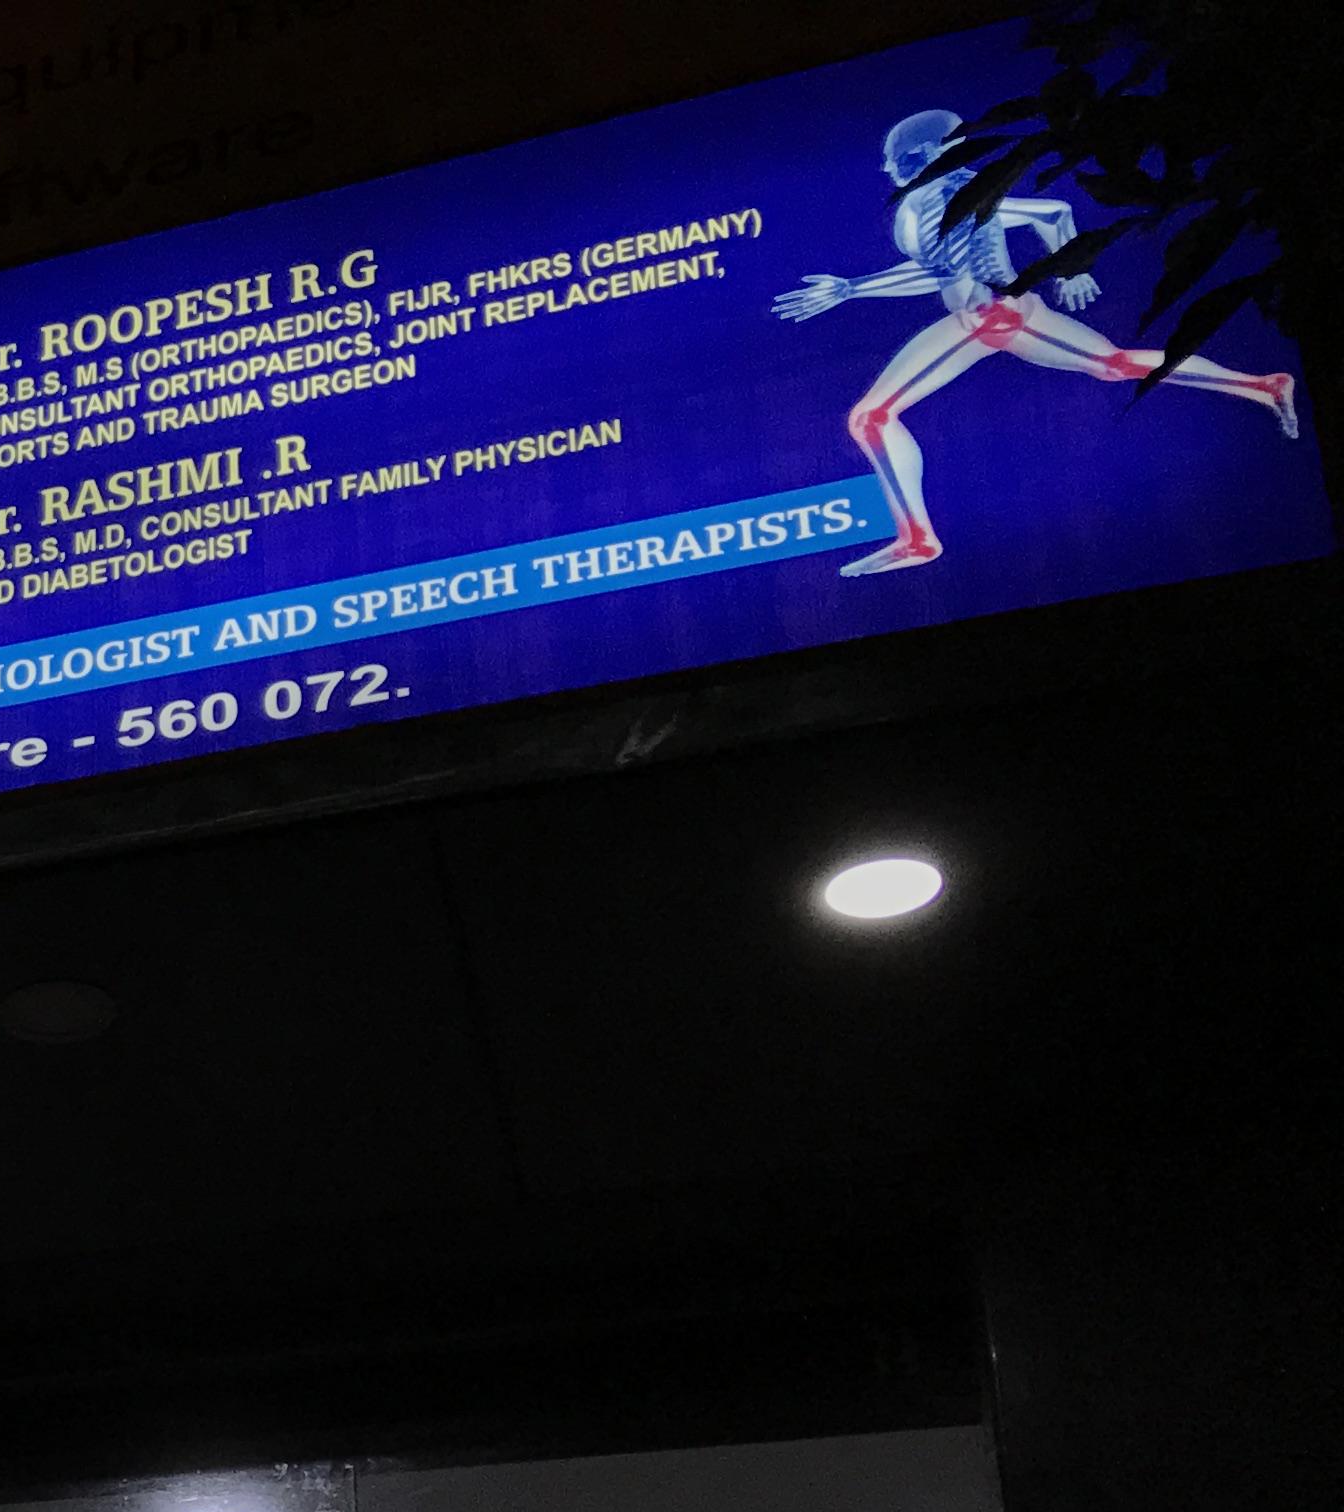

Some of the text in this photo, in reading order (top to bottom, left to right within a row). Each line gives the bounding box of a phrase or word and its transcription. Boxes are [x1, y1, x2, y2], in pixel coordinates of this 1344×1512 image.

[40, 273, 273, 362] ROOPESH
[289, 249, 378, 304] R.G
[75, 356, 124, 388] M.S
[131, 299, 381, 381] (ORTHOPAEDICS),
[389, 280, 460, 317] FIJR,
[468, 252, 573, 298] FHKRS
[580, 207, 762, 277] (GERMANY)
[147, 331, 381, 403] ORTHOPAEDICS,
[388, 307, 477, 349] JOINT
[484, 250, 725, 327] REPLACEMENT,
[75, 417, 136, 451] AND
[141, 388, 265, 435] TRAUMA
[269, 353, 416, 408] SURGEON
[40, 447, 244, 527] RASHMI
[262, 435, 312, 480] .R
[73, 523, 132, 555] M.D,
[140, 478, 333, 541] CONSULTANT
[340, 454, 447, 500] FAMILY
[454, 418, 622, 477] PHYSICIAN
[22, 528, 253, 599] DIABETOLOGIST
[213, 604, 317, 652] AND
[333, 563, 518, 628] SPEECH
[532, 498, 867, 588] THERAPISTS.
[117, 692, 238, 747] 560
[263, 664, 410, 720] 072.
